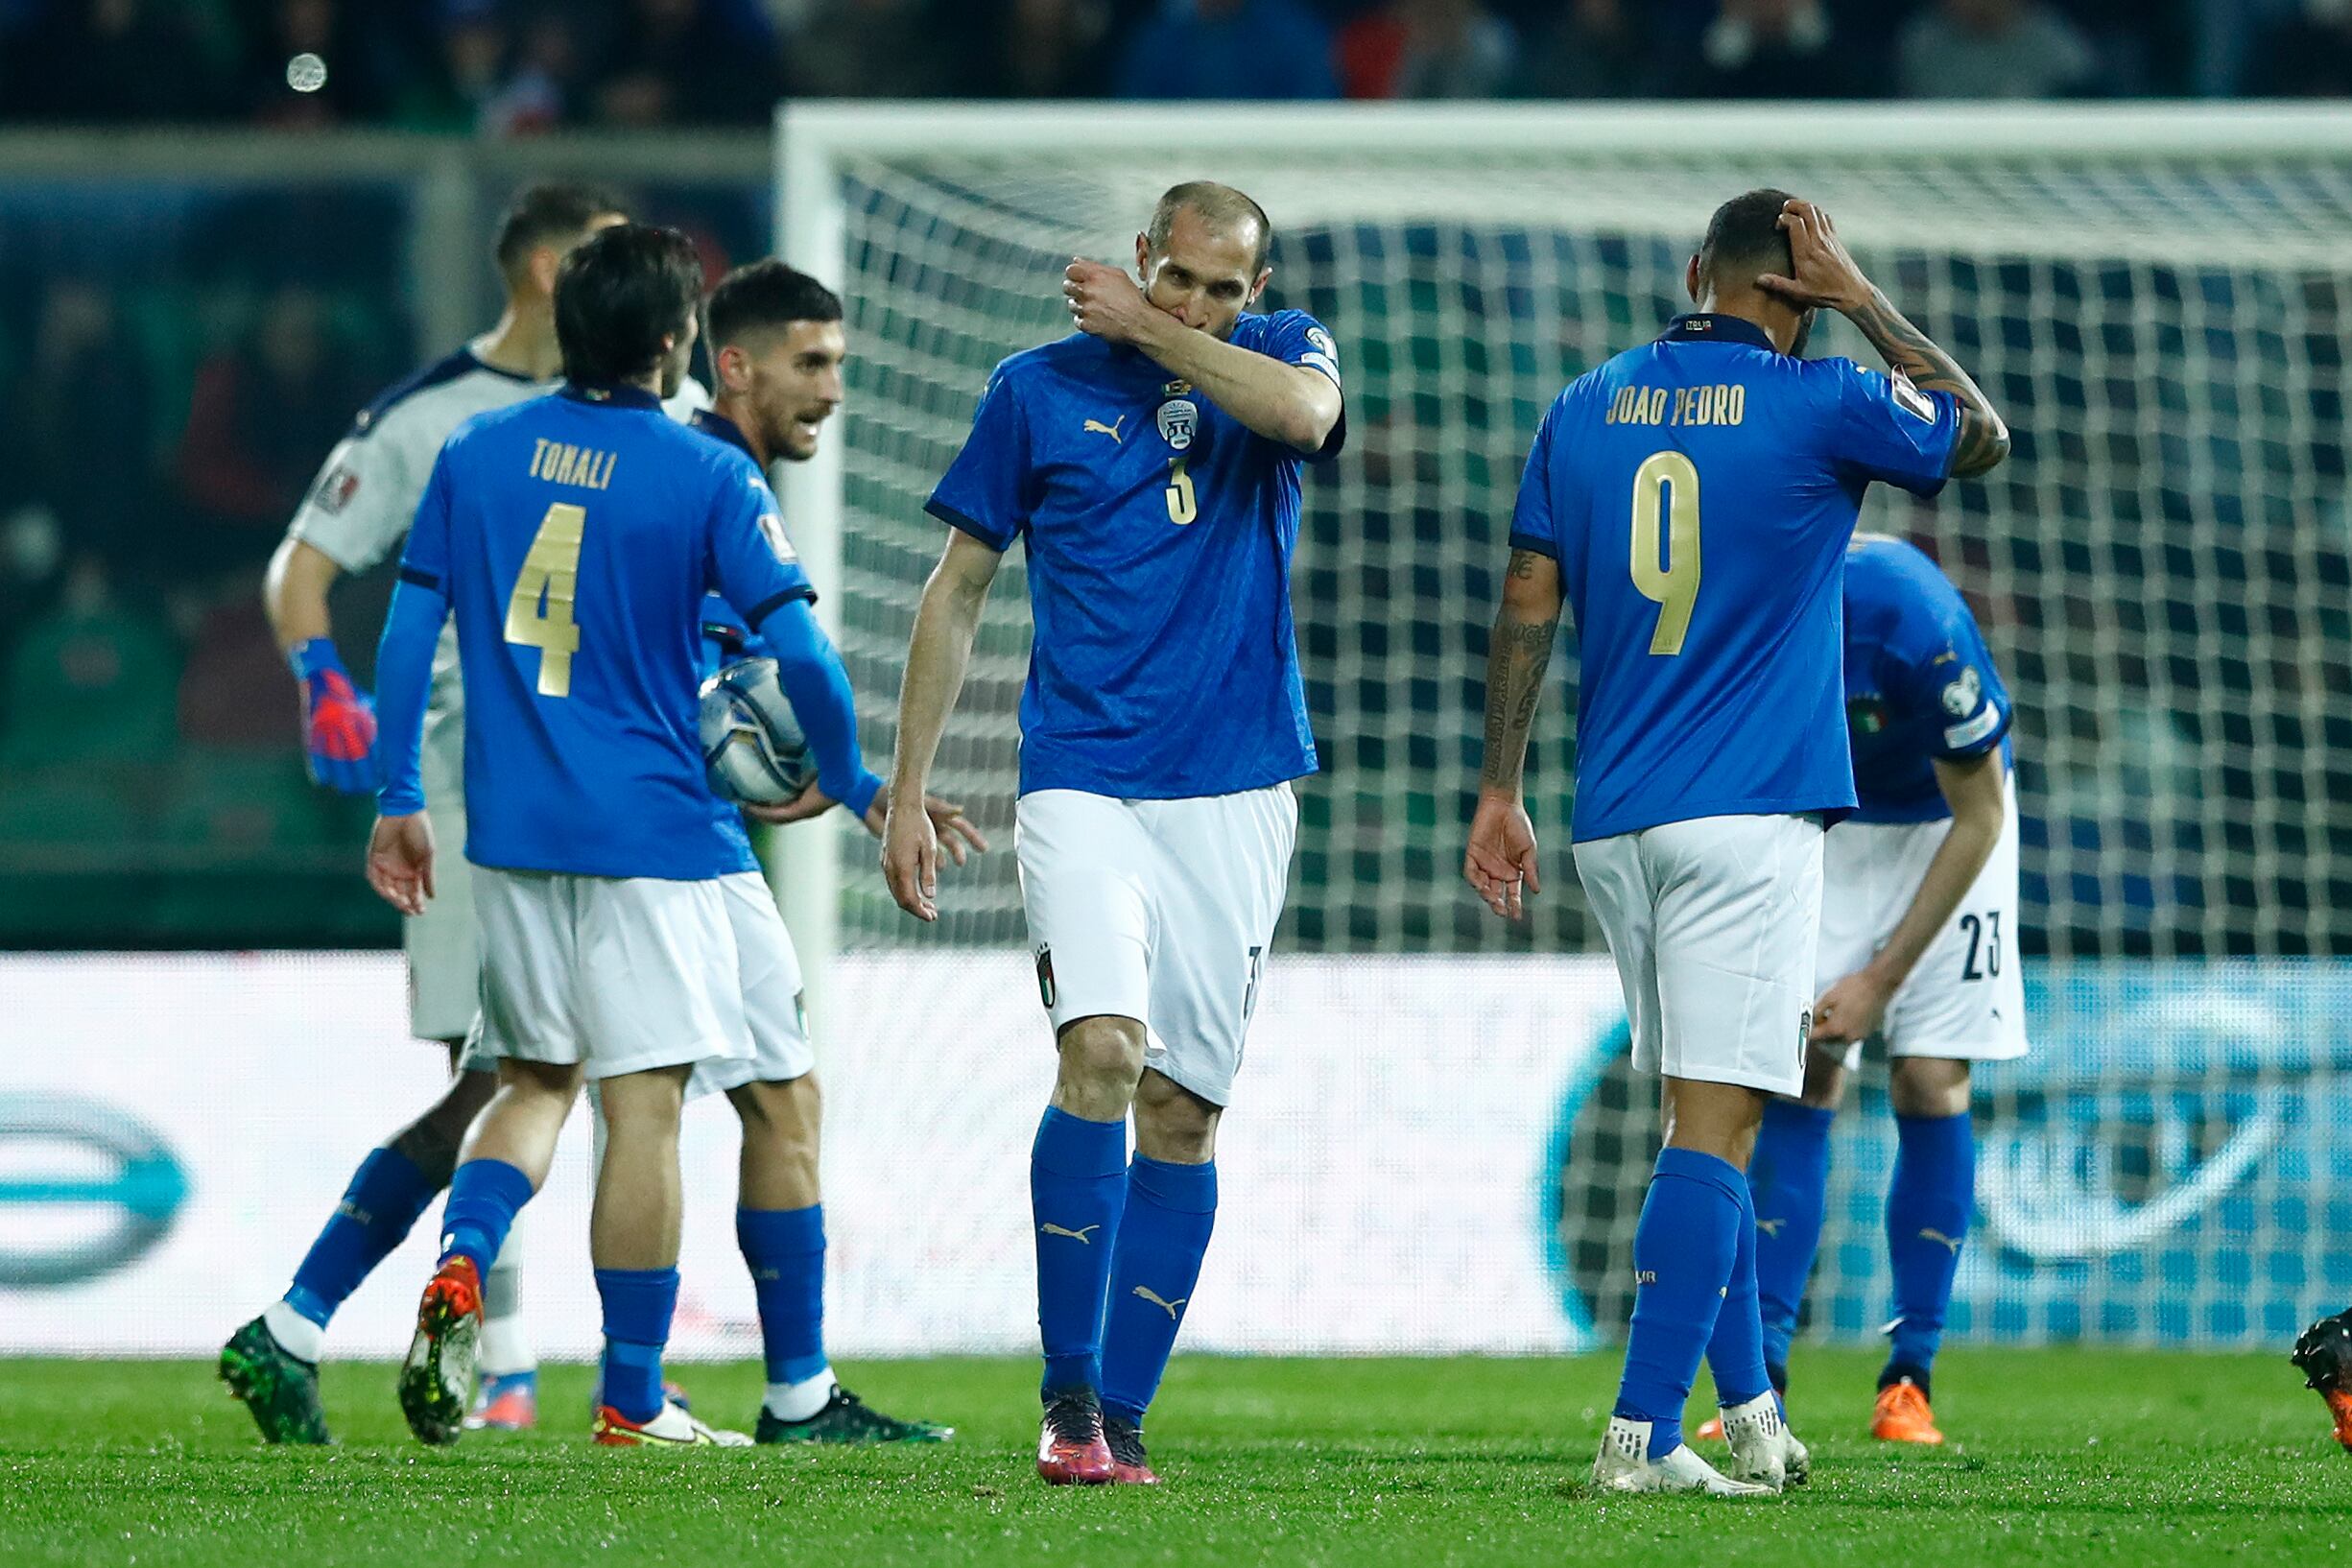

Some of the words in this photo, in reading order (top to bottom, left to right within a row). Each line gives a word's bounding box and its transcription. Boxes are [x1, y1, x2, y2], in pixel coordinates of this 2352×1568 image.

[1606, 386, 1668, 425] JOAO
[1671, 385, 1745, 426] PEDRO
[529, 438, 617, 490] TONALI
[1166, 457, 1198, 525] 3
[1630, 450, 1700, 655] 9
[504, 502, 586, 697] 4
[1960, 911, 2001, 981] 23
